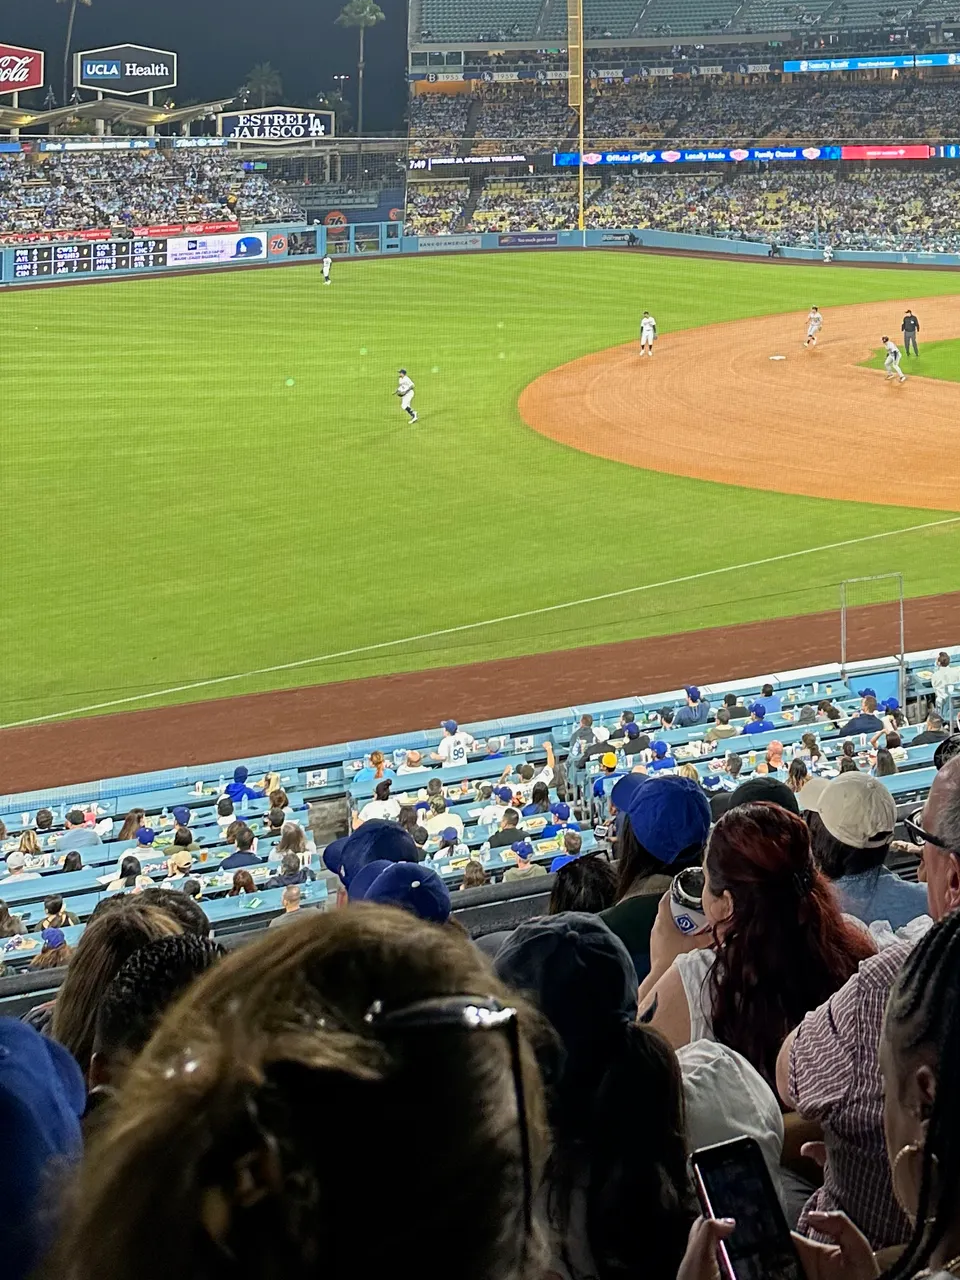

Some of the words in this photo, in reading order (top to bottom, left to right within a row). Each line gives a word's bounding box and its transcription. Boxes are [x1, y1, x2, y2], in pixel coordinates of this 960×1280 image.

[86, 64, 119, 75] UCLA
[125, 63, 169, 76] Health
[230, 125, 305, 138] JALISCO
[606, 154, 631, 162] Official
[271, 240, 284, 250] 76
[452, 747, 465, 760] 99
